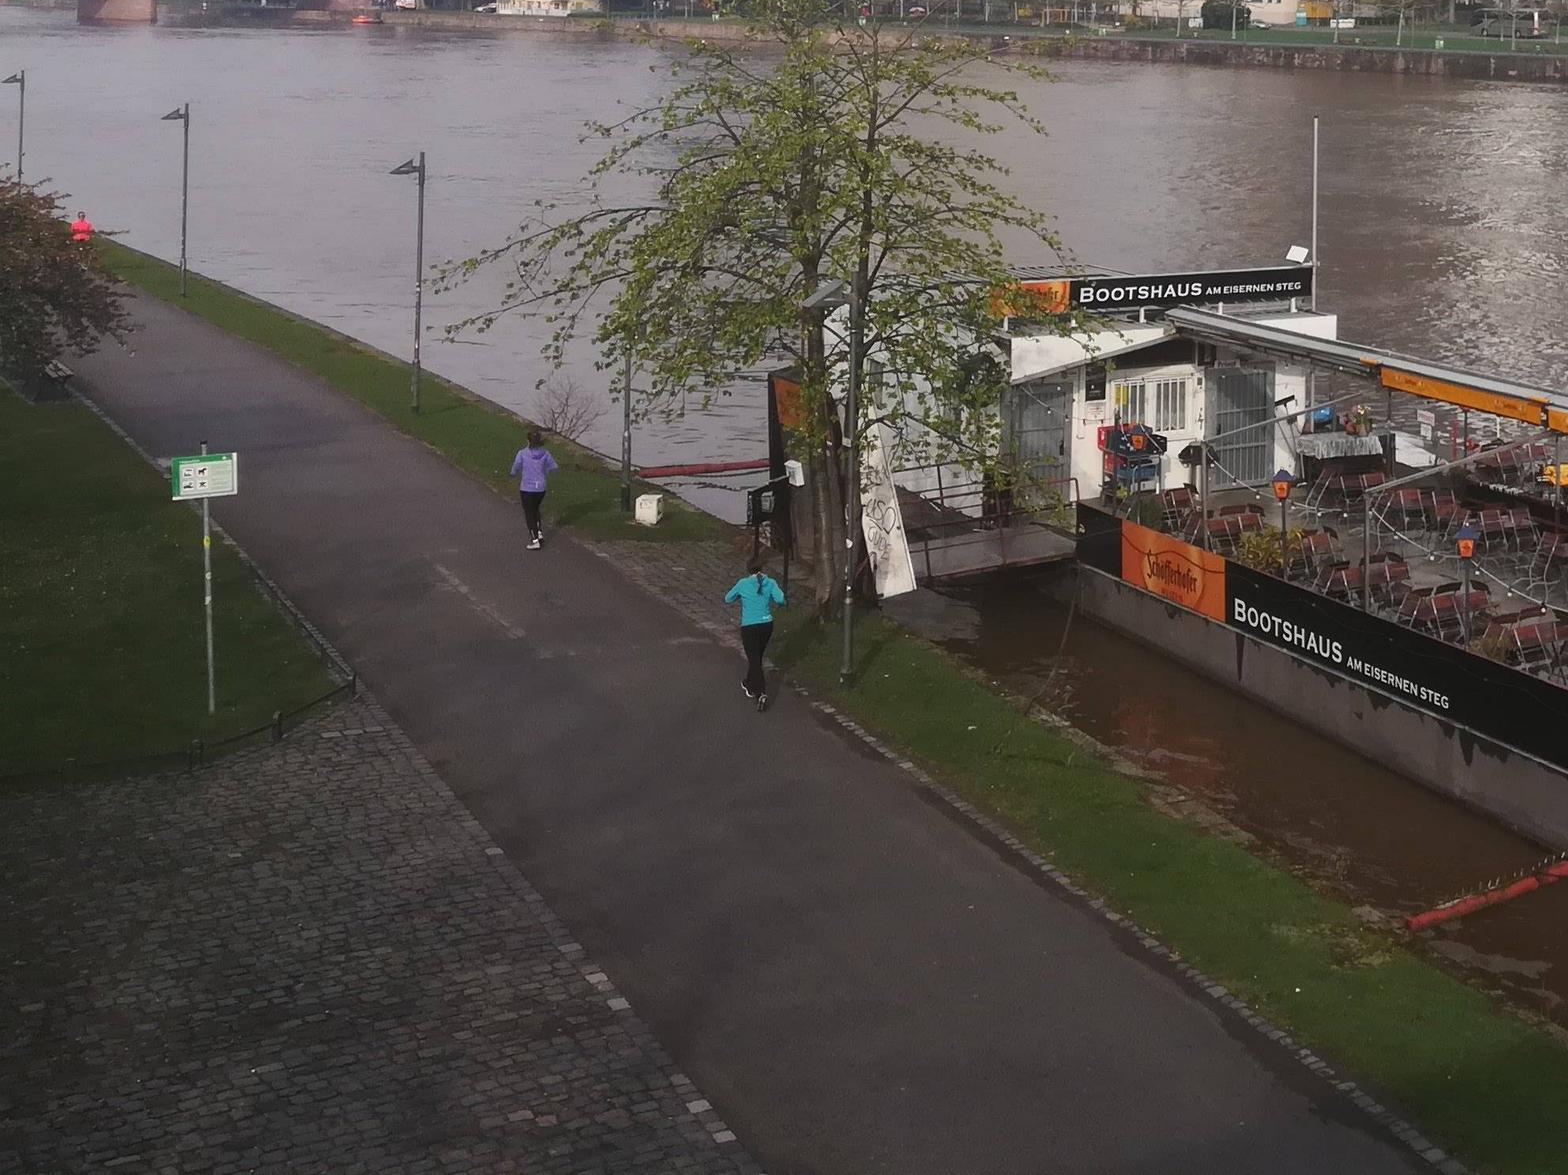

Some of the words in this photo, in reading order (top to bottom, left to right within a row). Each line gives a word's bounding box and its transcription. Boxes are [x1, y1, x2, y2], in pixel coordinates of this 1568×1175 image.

[1080, 282, 1203, 303] BOOTSHAUS
[1205, 286, 1221, 295] AM
[1223, 283, 1275, 294] EISERNEN
[1275, 281, 1302, 291] STEG
[1234, 597, 1343, 664] BOOTSHAUS
[1346, 656, 1363, 673] AM
[1363, 662, 1420, 697] EISERNEN
[1419, 686, 1450, 710] STEG
